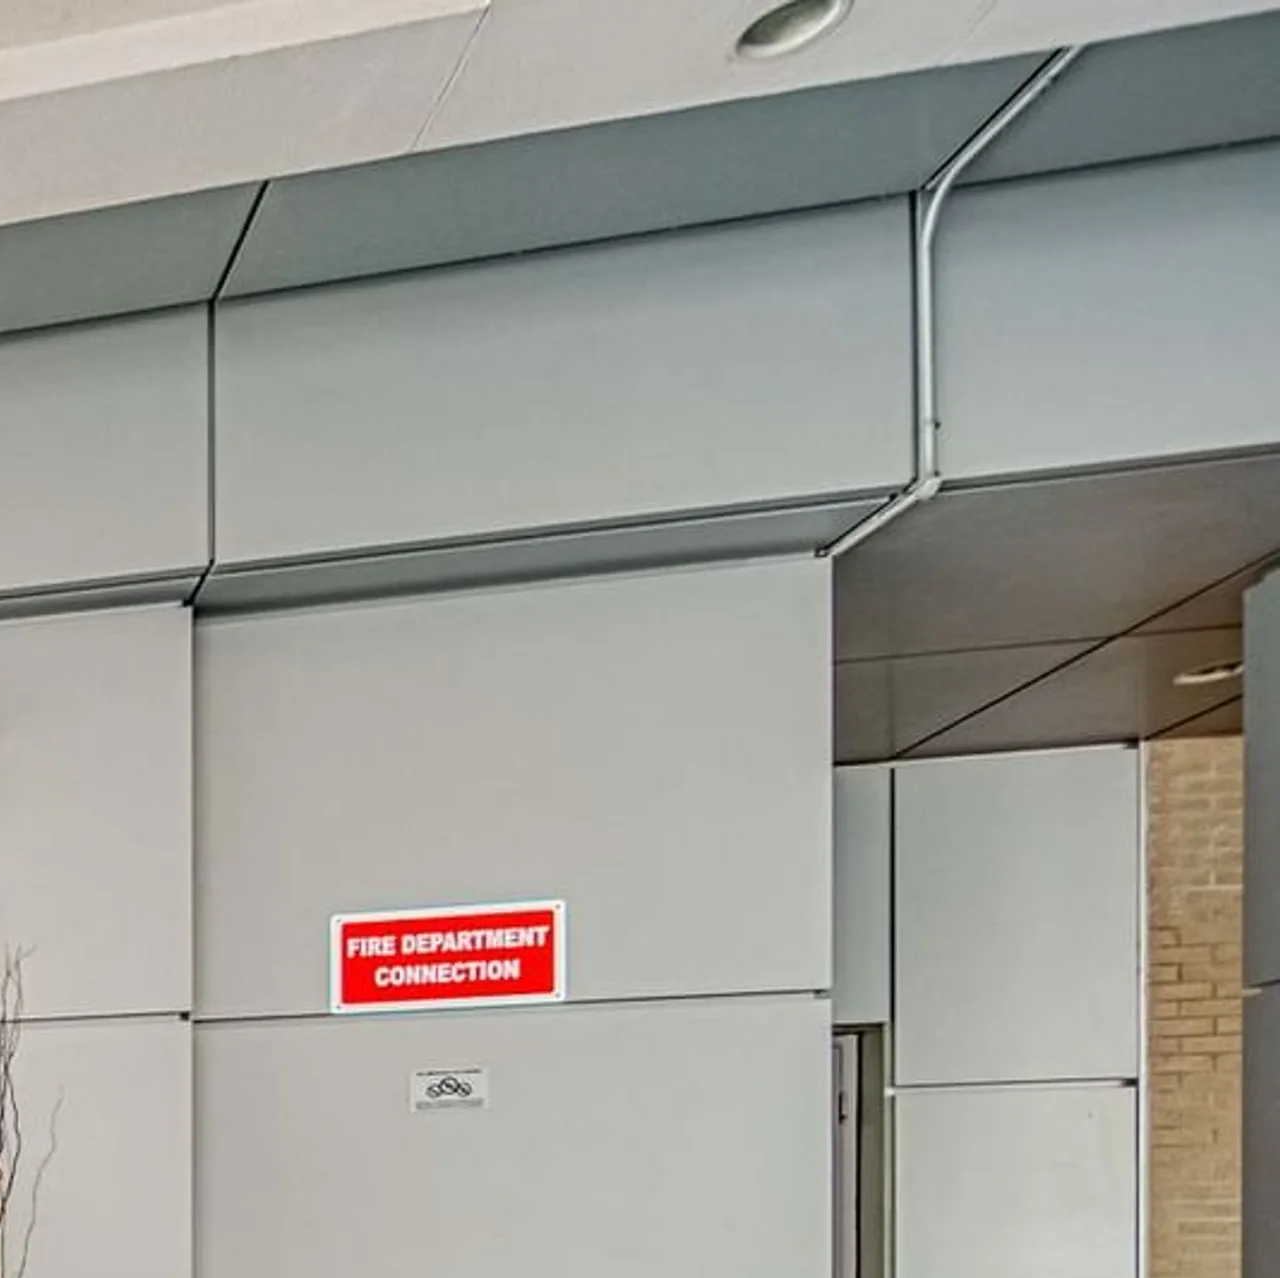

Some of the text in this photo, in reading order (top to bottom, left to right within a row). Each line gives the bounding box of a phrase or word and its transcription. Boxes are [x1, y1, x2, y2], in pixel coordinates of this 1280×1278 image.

[346, 926, 550, 958] FIRE DEPARTMENT
[374, 958, 521, 986] CONNECTION
